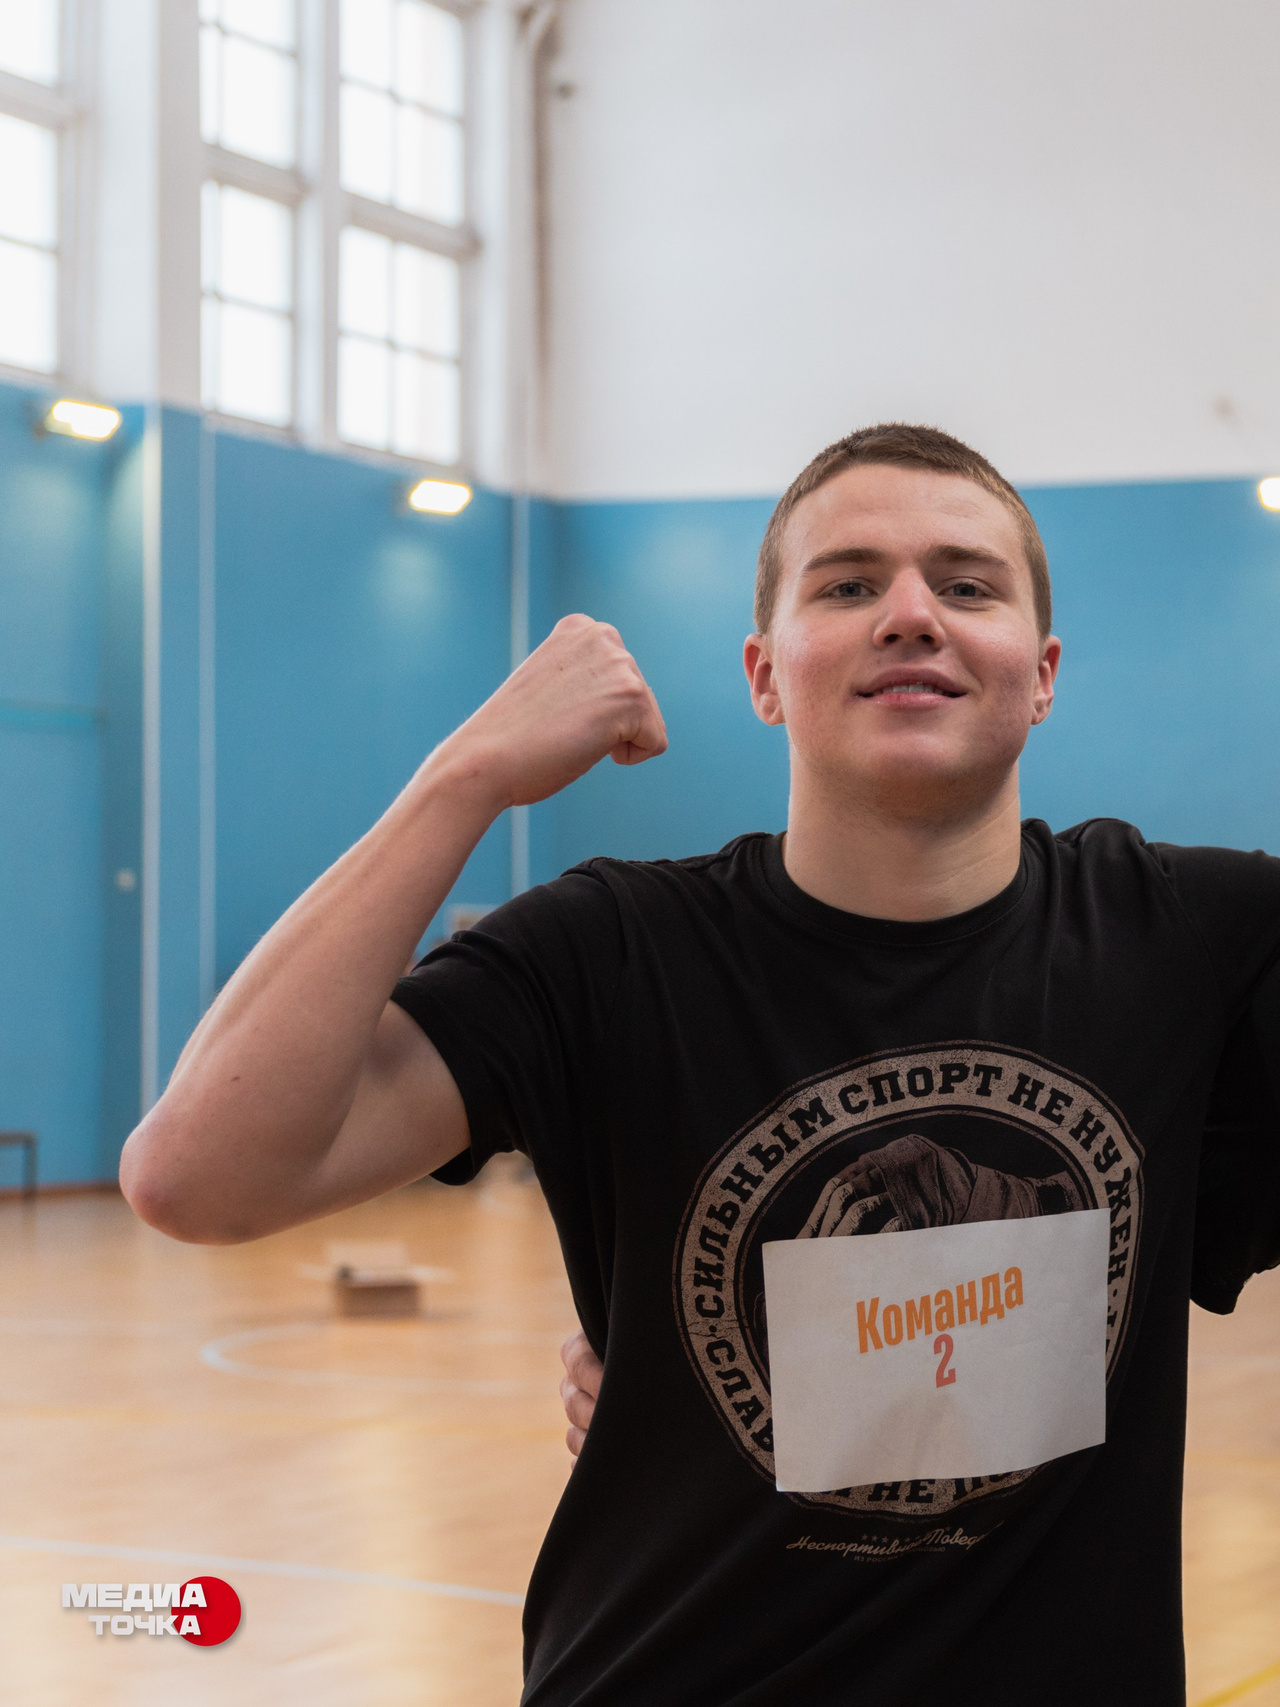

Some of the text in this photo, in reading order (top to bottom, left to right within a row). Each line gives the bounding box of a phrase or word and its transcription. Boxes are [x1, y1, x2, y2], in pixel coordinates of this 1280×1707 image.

[693, 1063, 1132, 1319] СИЛЬНЫМ СПОРТ НЕ НУЖЕН
[855, 1265, 1025, 1354] Команда
[933, 1333, 957, 1388] 2
